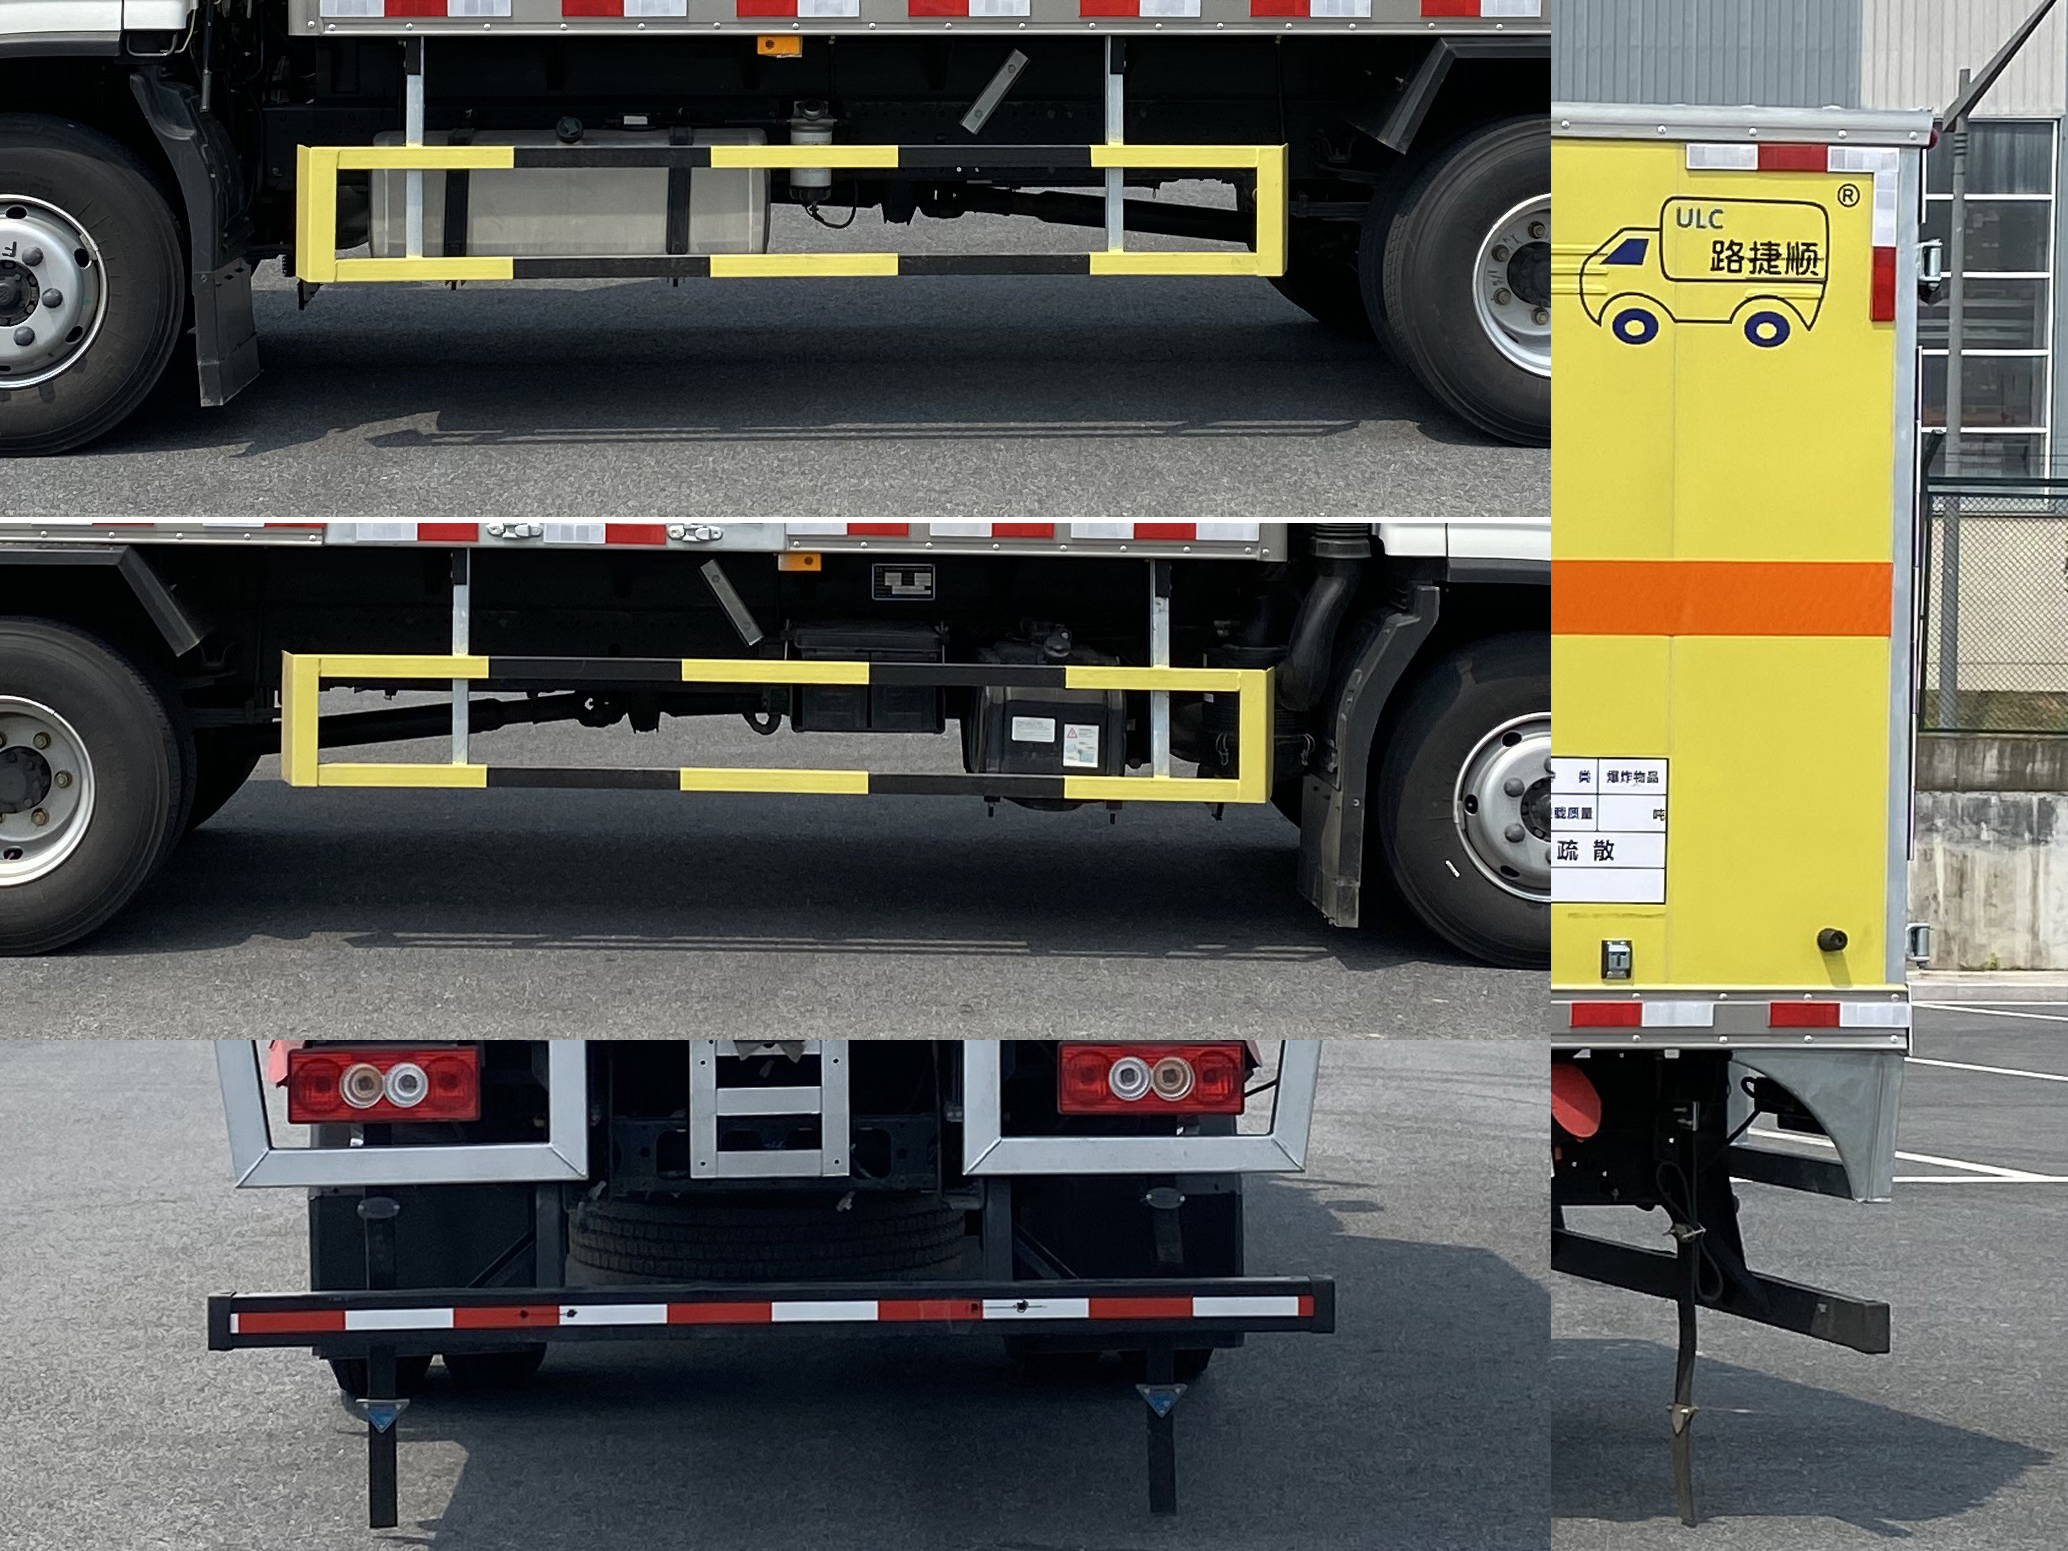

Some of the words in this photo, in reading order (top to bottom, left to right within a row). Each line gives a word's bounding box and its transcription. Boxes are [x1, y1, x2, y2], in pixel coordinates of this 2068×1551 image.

[1676, 207, 1724, 229] ULC
[1710, 239, 1819, 276] 路捷顺
[1606, 770, 1659, 783] 爆炸物品
[1551, 806, 1593, 820] 载质量
[1652, 809, 1665, 821] 吨
